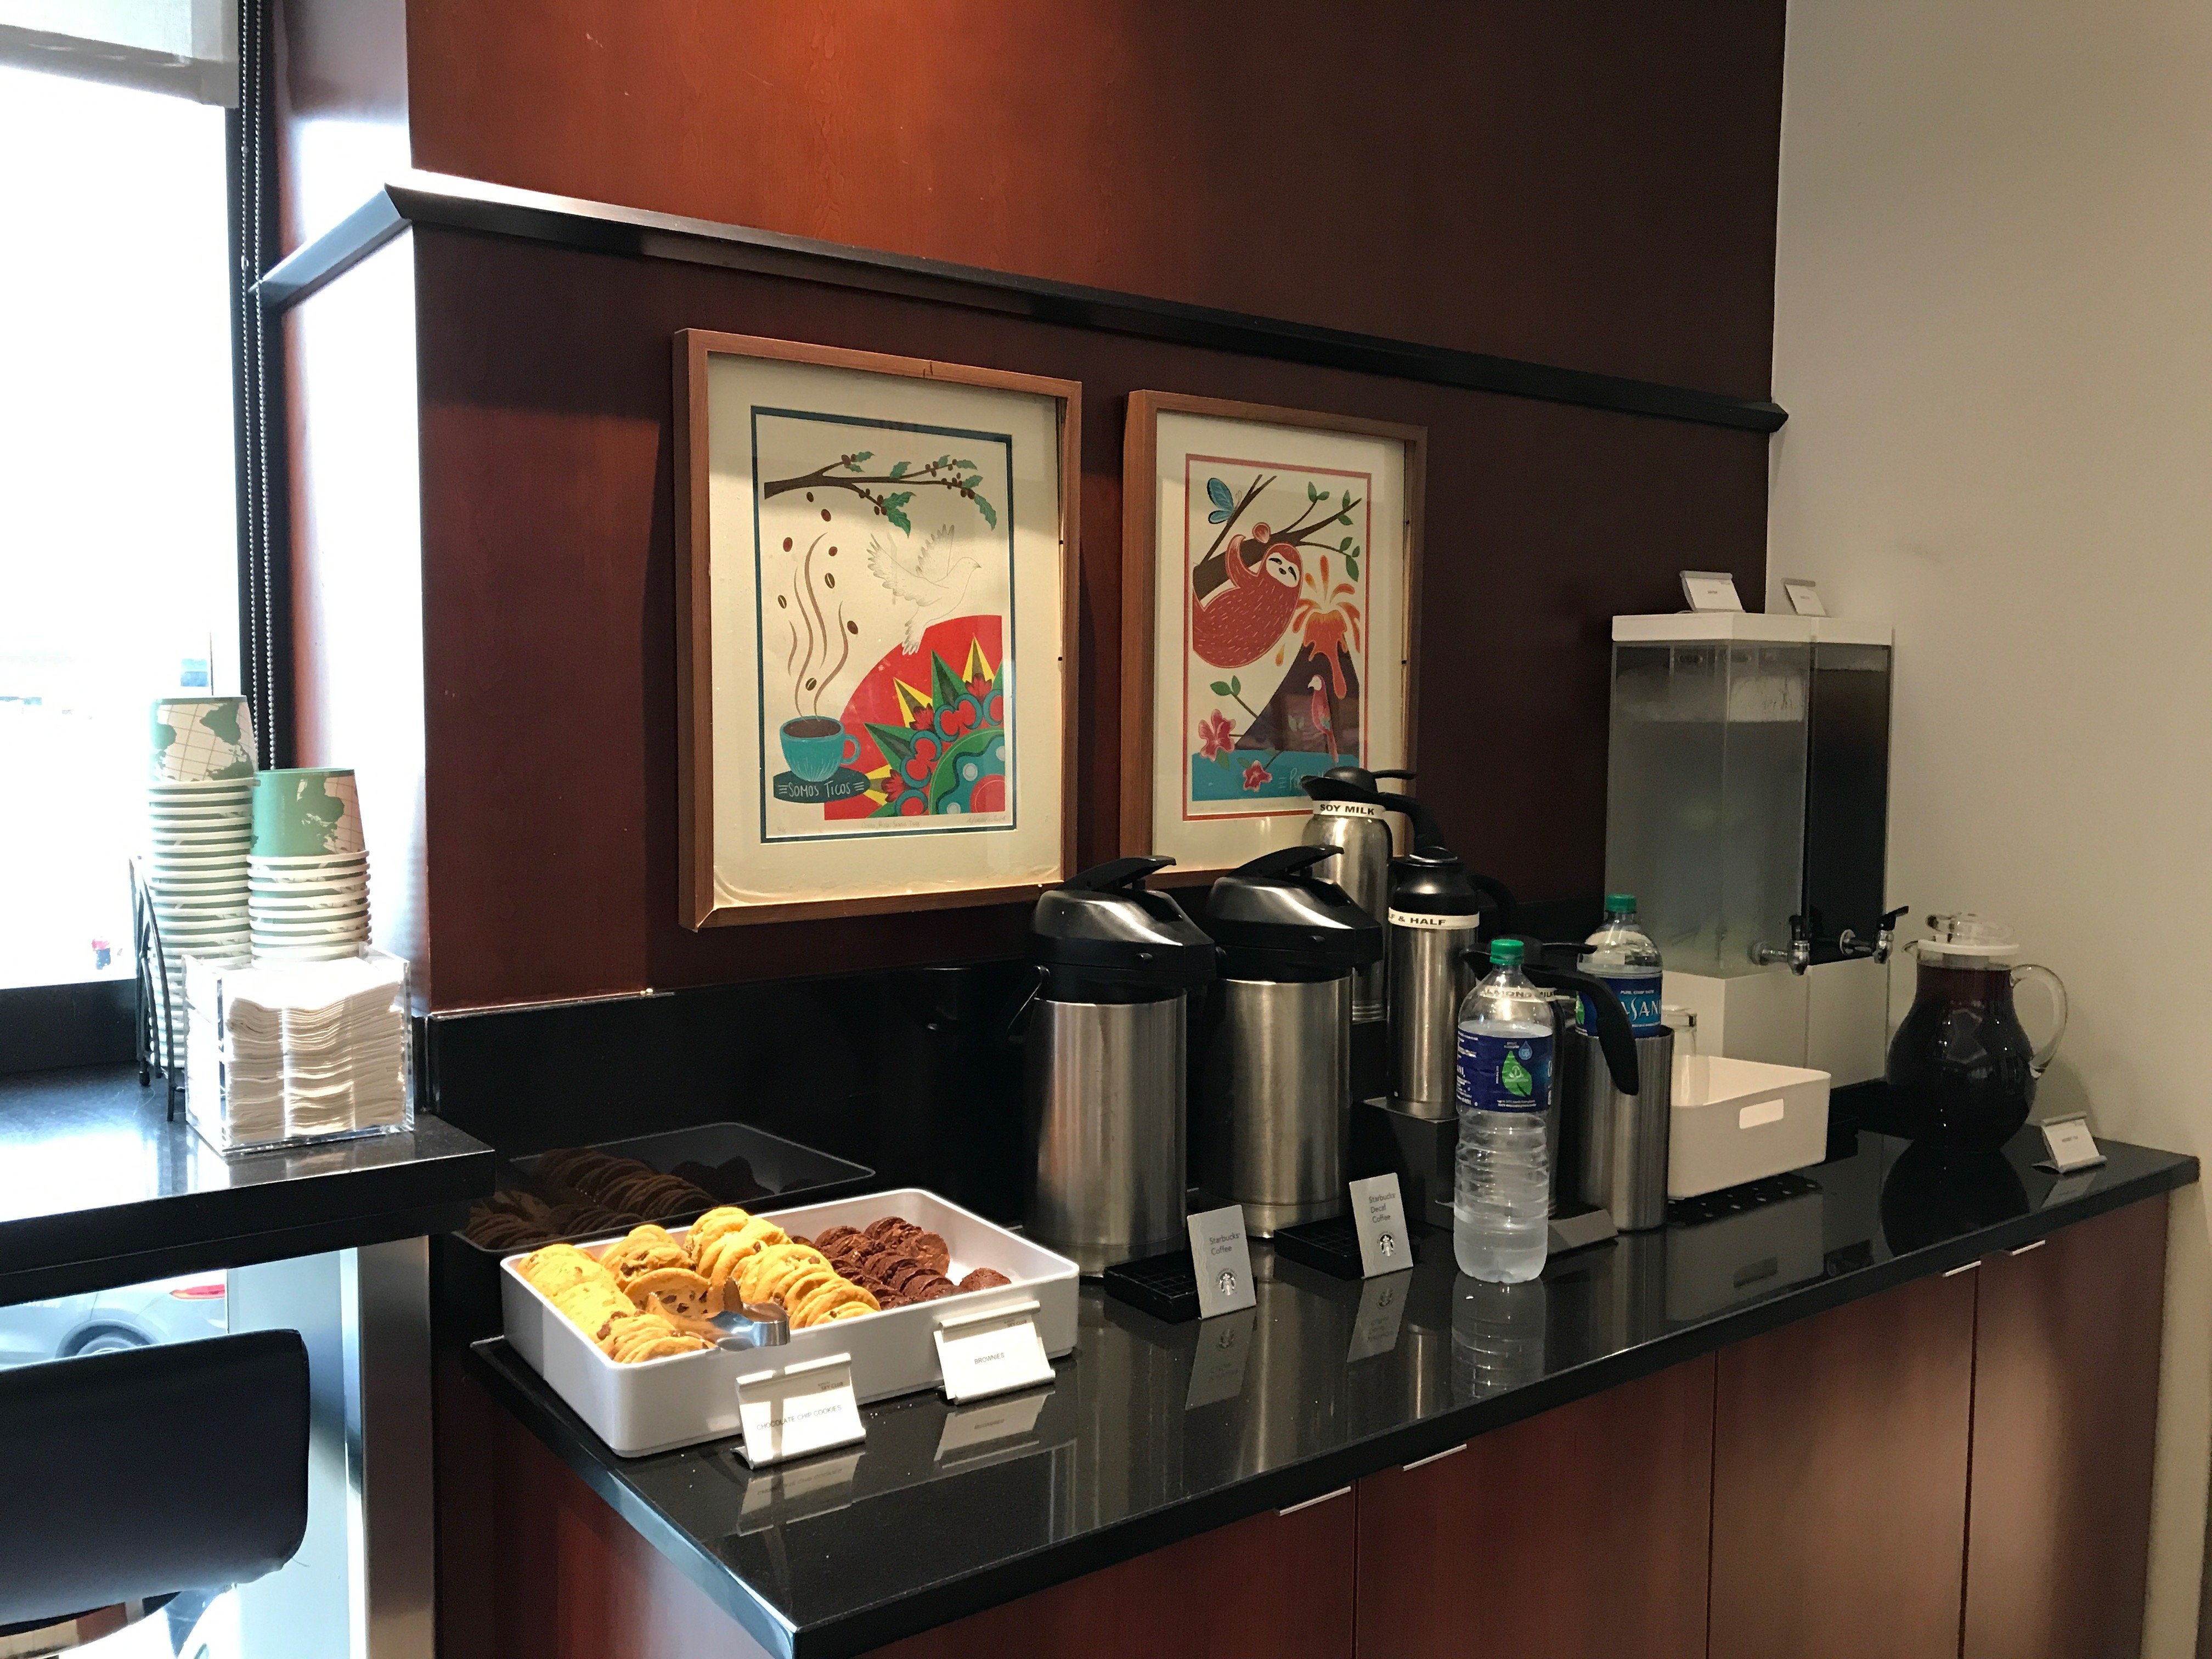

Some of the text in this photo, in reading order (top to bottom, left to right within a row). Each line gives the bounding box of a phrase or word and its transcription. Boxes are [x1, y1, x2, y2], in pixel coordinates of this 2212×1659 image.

[788, 782, 819, 797] SOMOS
[1320, 804, 1375, 815] SOY MILK
[1410, 917, 1446, 926] HALF
[1621, 997, 1662, 1021] ASANI
[1372, 1214, 1391, 1223] Coffee
[1209, 1232, 1240, 1245] Starbucks
[1211, 1245, 1232, 1255] Coffee
[974, 1352, 1005, 1364] BROWNIES
[757, 1404, 842, 1430] CHOCOLATE CHIP COOKIES
